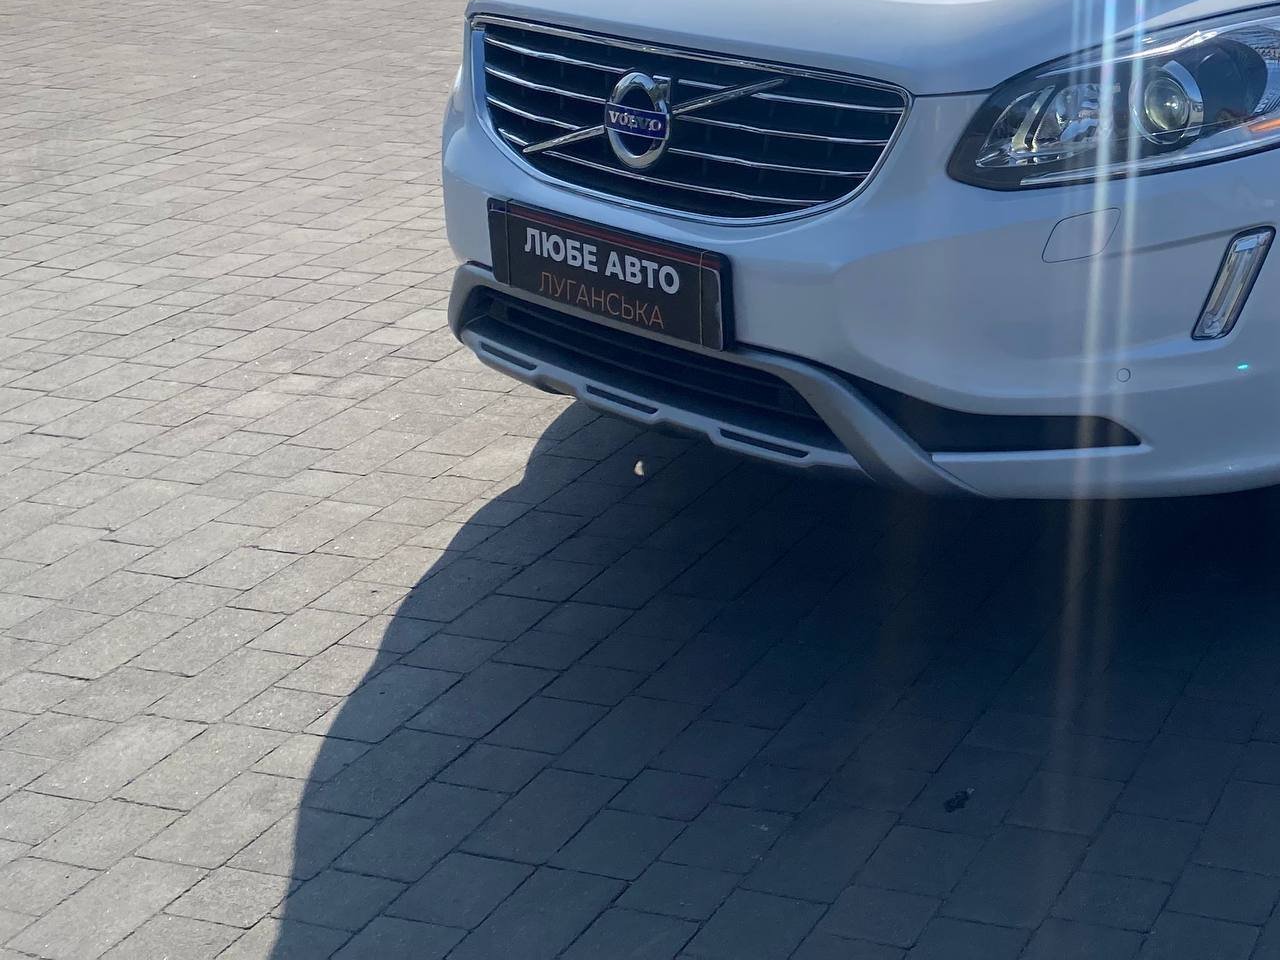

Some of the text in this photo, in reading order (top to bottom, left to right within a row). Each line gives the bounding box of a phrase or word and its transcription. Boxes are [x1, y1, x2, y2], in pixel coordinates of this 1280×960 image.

[608, 110, 662, 132] VOLVO
[525, 227, 680, 294] ЛЮБЕ АВТО
[539, 271, 664, 329] ЛУГАНСЬКА
